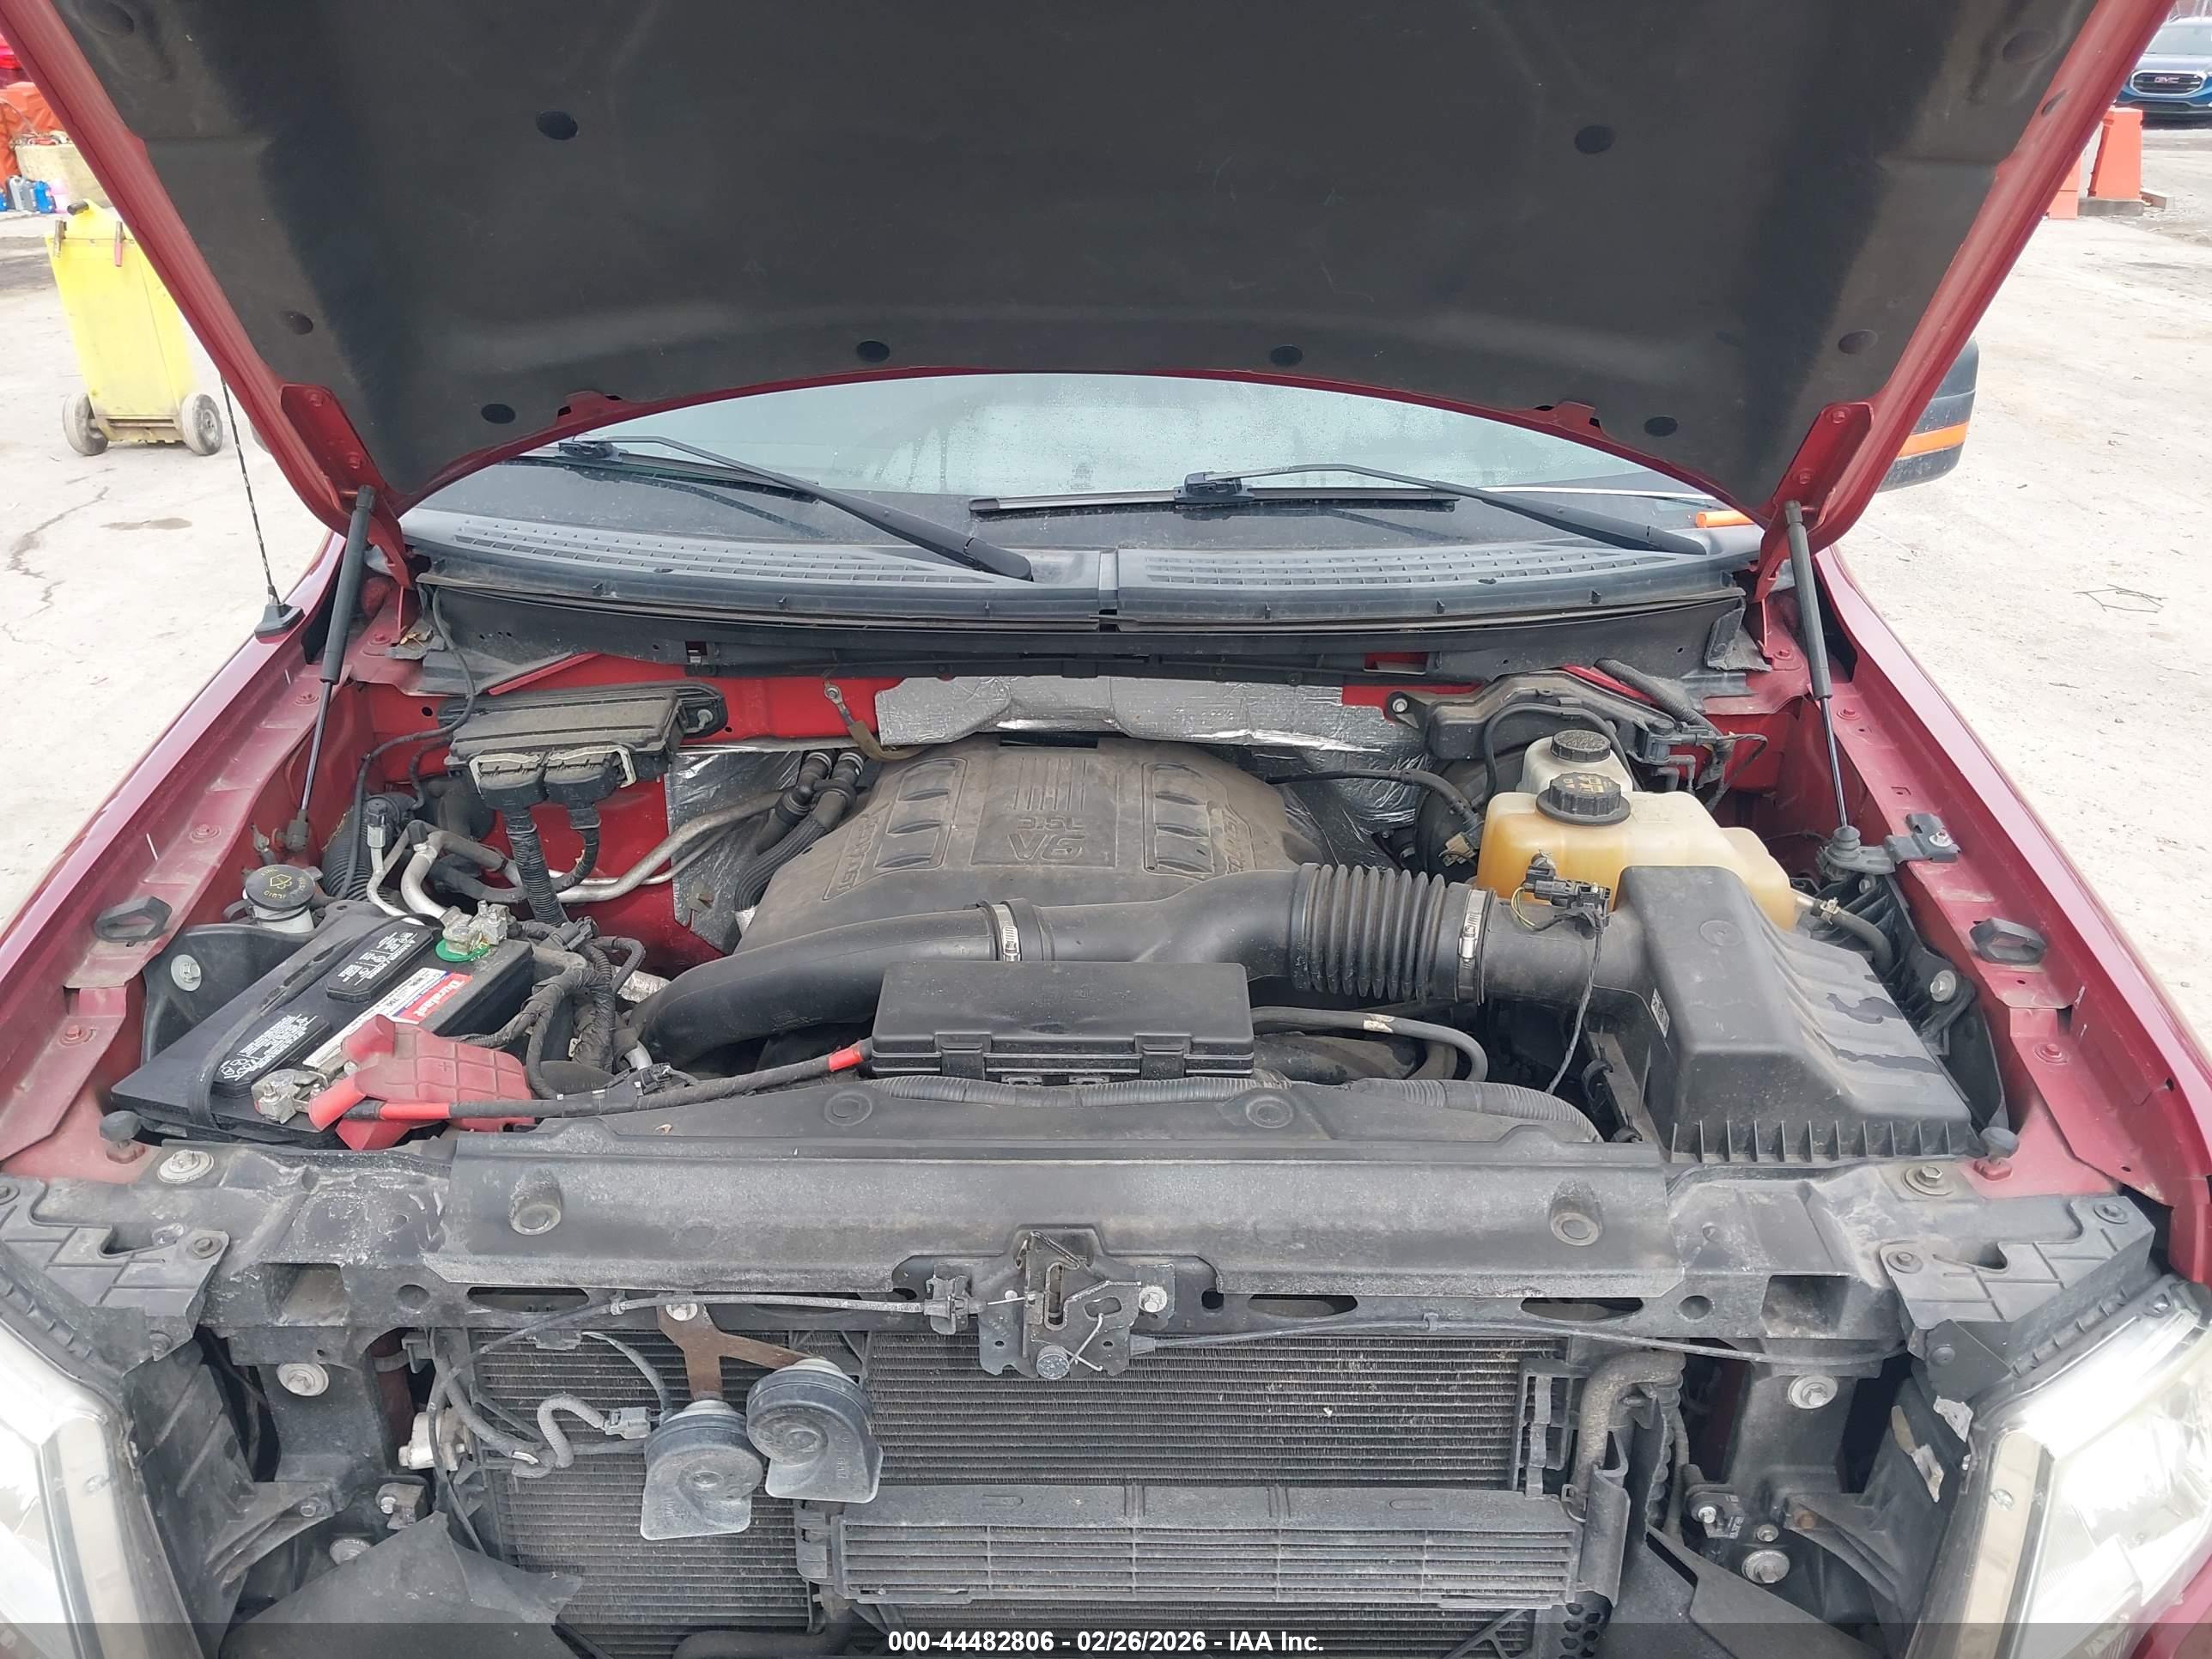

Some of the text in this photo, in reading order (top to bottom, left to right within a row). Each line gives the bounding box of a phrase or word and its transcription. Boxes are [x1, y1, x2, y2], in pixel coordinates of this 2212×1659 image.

[1017, 817, 1085, 831] 3.5L
[1007, 834, 1085, 860] V6
[413, 980, 465, 1018] Duralast
